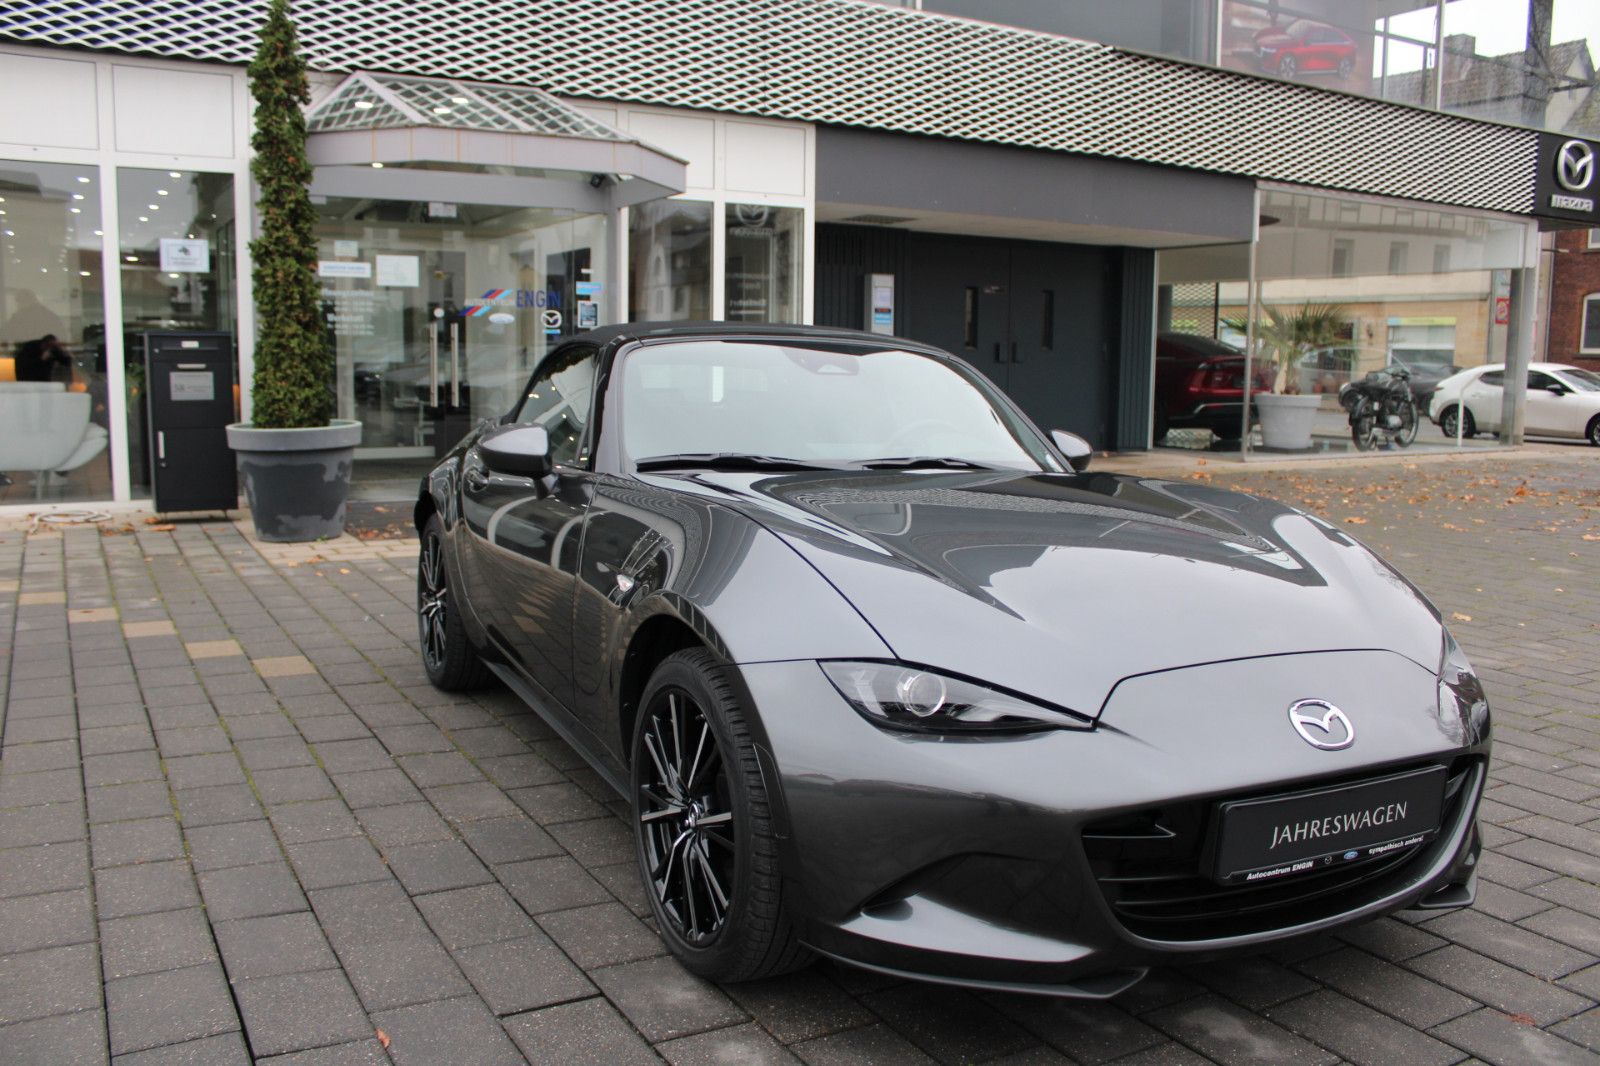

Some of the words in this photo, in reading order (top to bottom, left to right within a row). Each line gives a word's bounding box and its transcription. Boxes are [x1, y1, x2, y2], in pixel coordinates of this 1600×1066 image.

[516, 289, 561, 308] ENGIN
[1270, 801, 1408, 849] JAHRESWAGEN
[1246, 866, 1291, 881] Autocentrum
[1292, 860, 1315, 873] ENGIN
[1368, 841, 1404, 855] sympathisch
